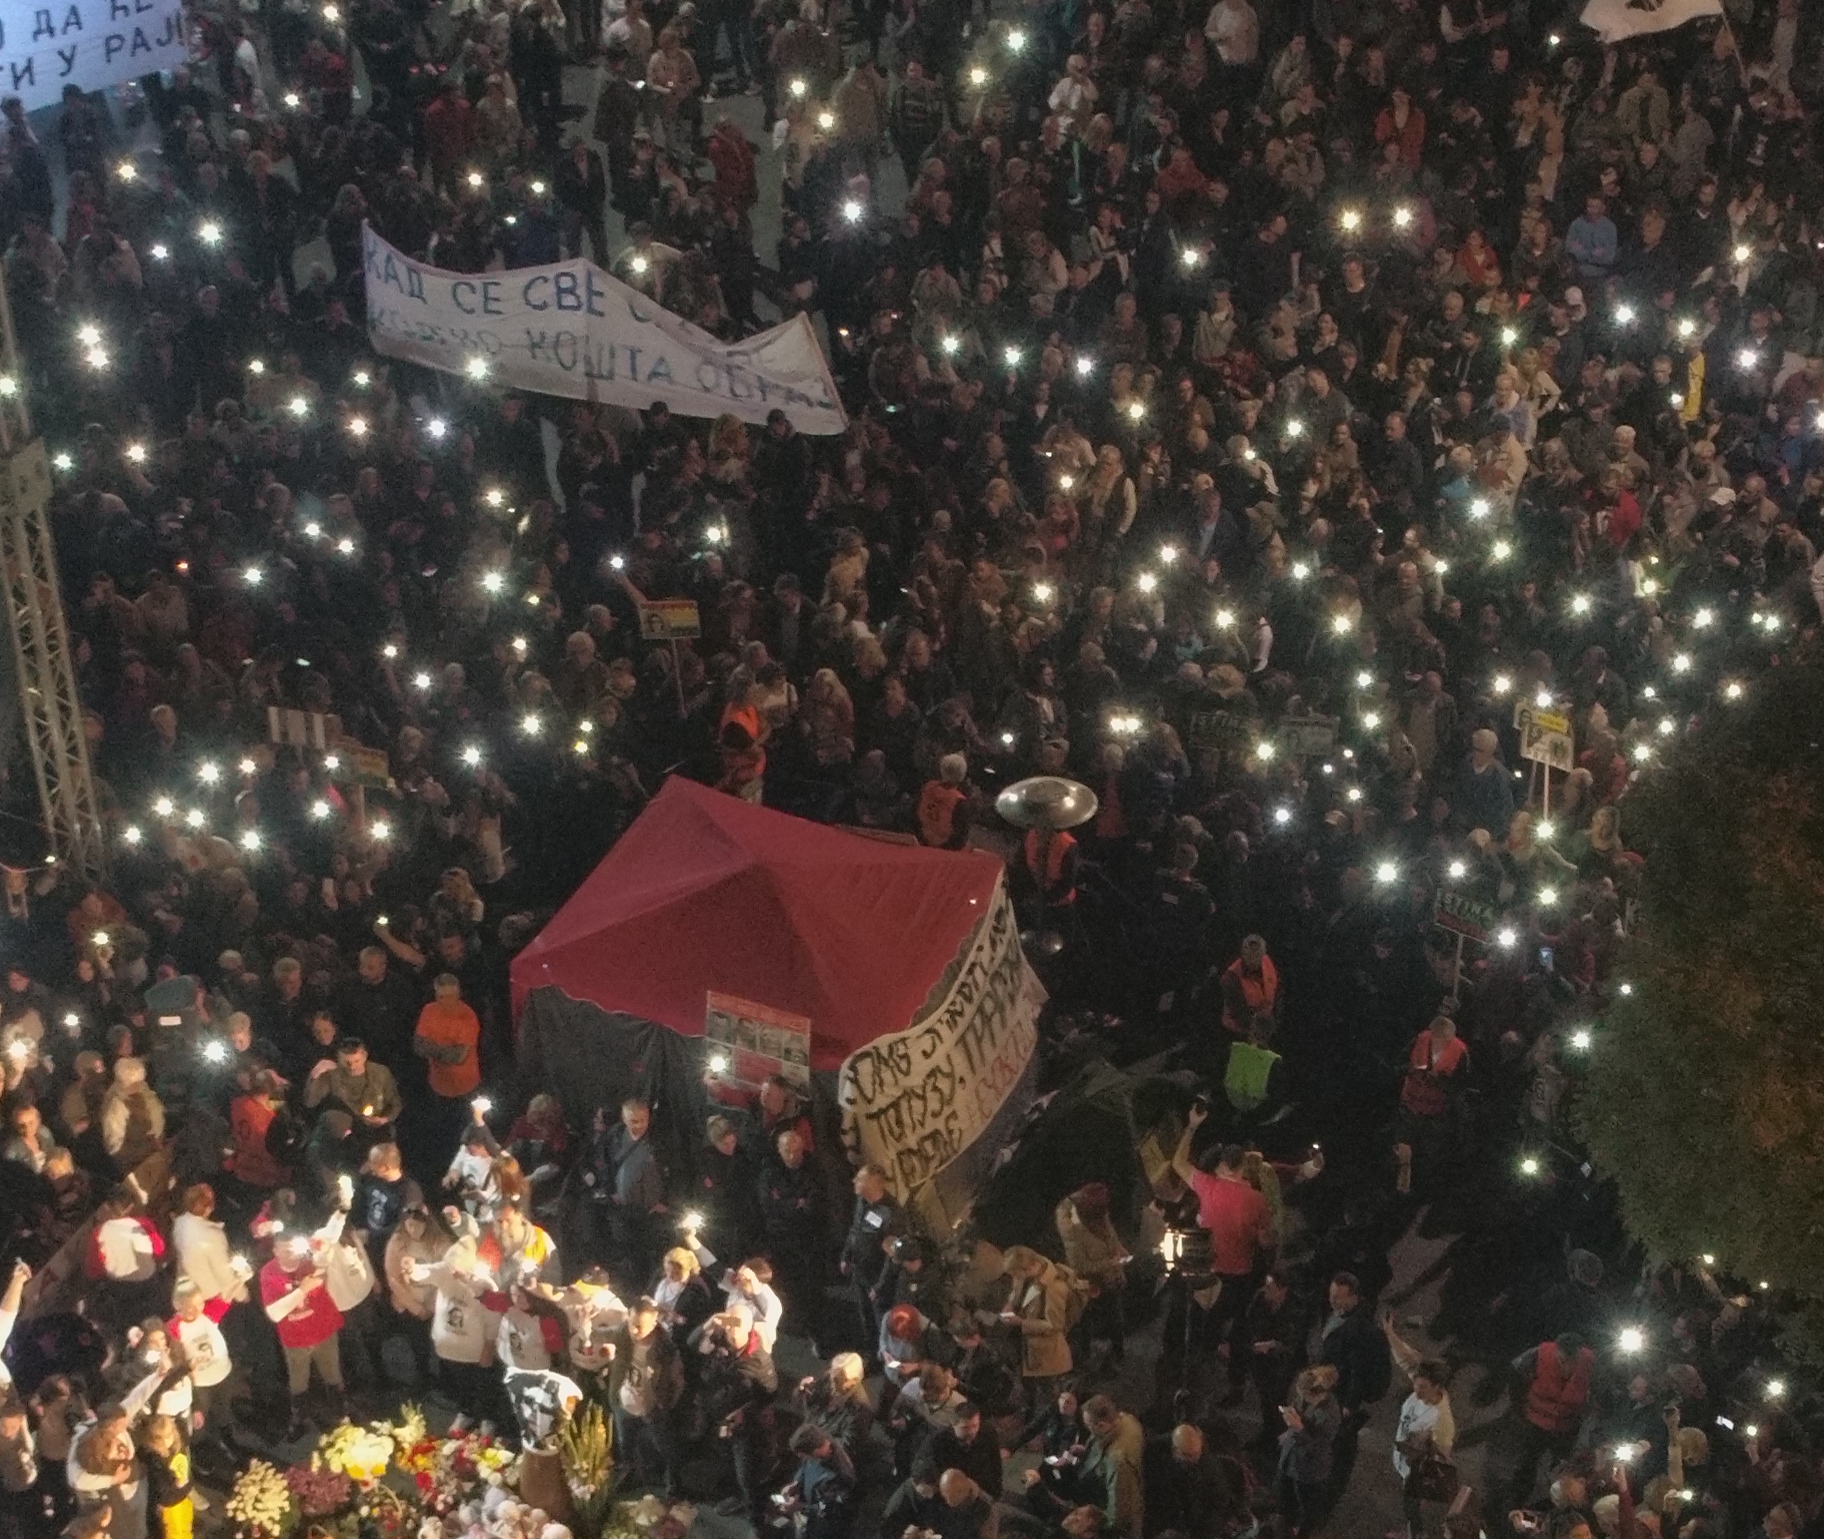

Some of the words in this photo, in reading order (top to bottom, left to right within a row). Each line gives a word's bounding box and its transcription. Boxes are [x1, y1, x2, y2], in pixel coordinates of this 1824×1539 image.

[33, 4, 83, 42] ДА
[58, 45, 77, 77] У
[452, 281, 504, 315] СЕ
[523, 270, 606, 318] СВЕ
[526, 328, 674, 386] КОШТА
